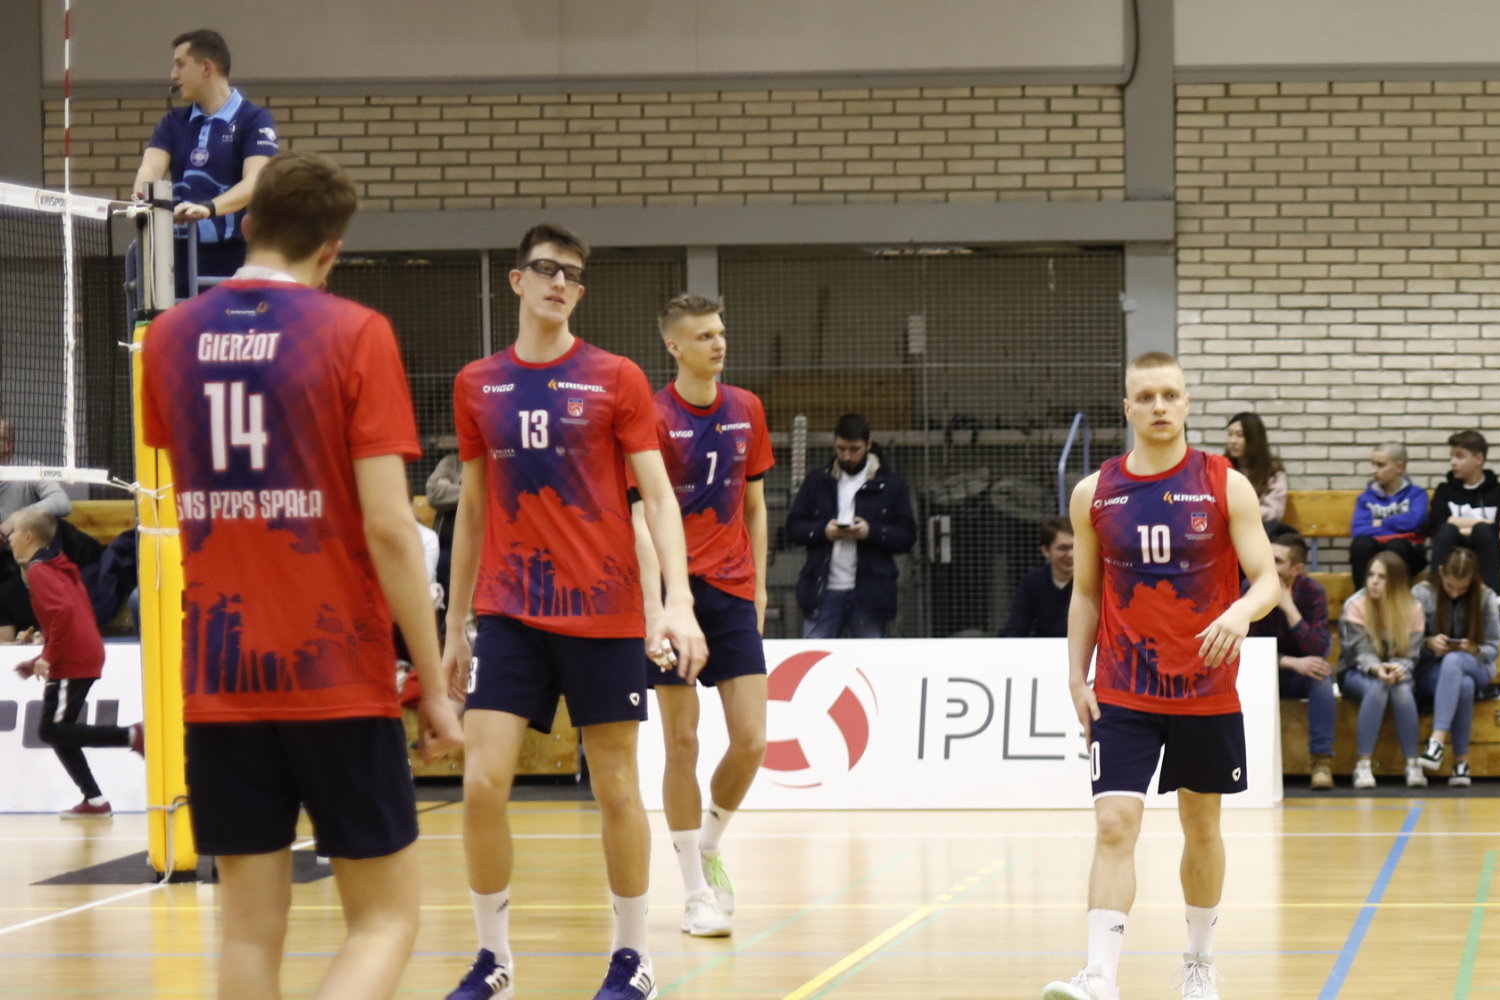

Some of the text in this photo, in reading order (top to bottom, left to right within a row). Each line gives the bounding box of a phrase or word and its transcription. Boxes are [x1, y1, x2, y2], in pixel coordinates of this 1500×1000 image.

[198, 329, 280, 362] GIERŻOT
[558, 381, 607, 393] KRISPOL
[204, 381, 268, 471] 14
[519, 409, 549, 449] 13
[706, 451, 718, 486] 7
[210, 490, 257, 520] PZPS
[260, 489, 323, 519] SPAŁA
[1137, 525, 1171, 564] 10
